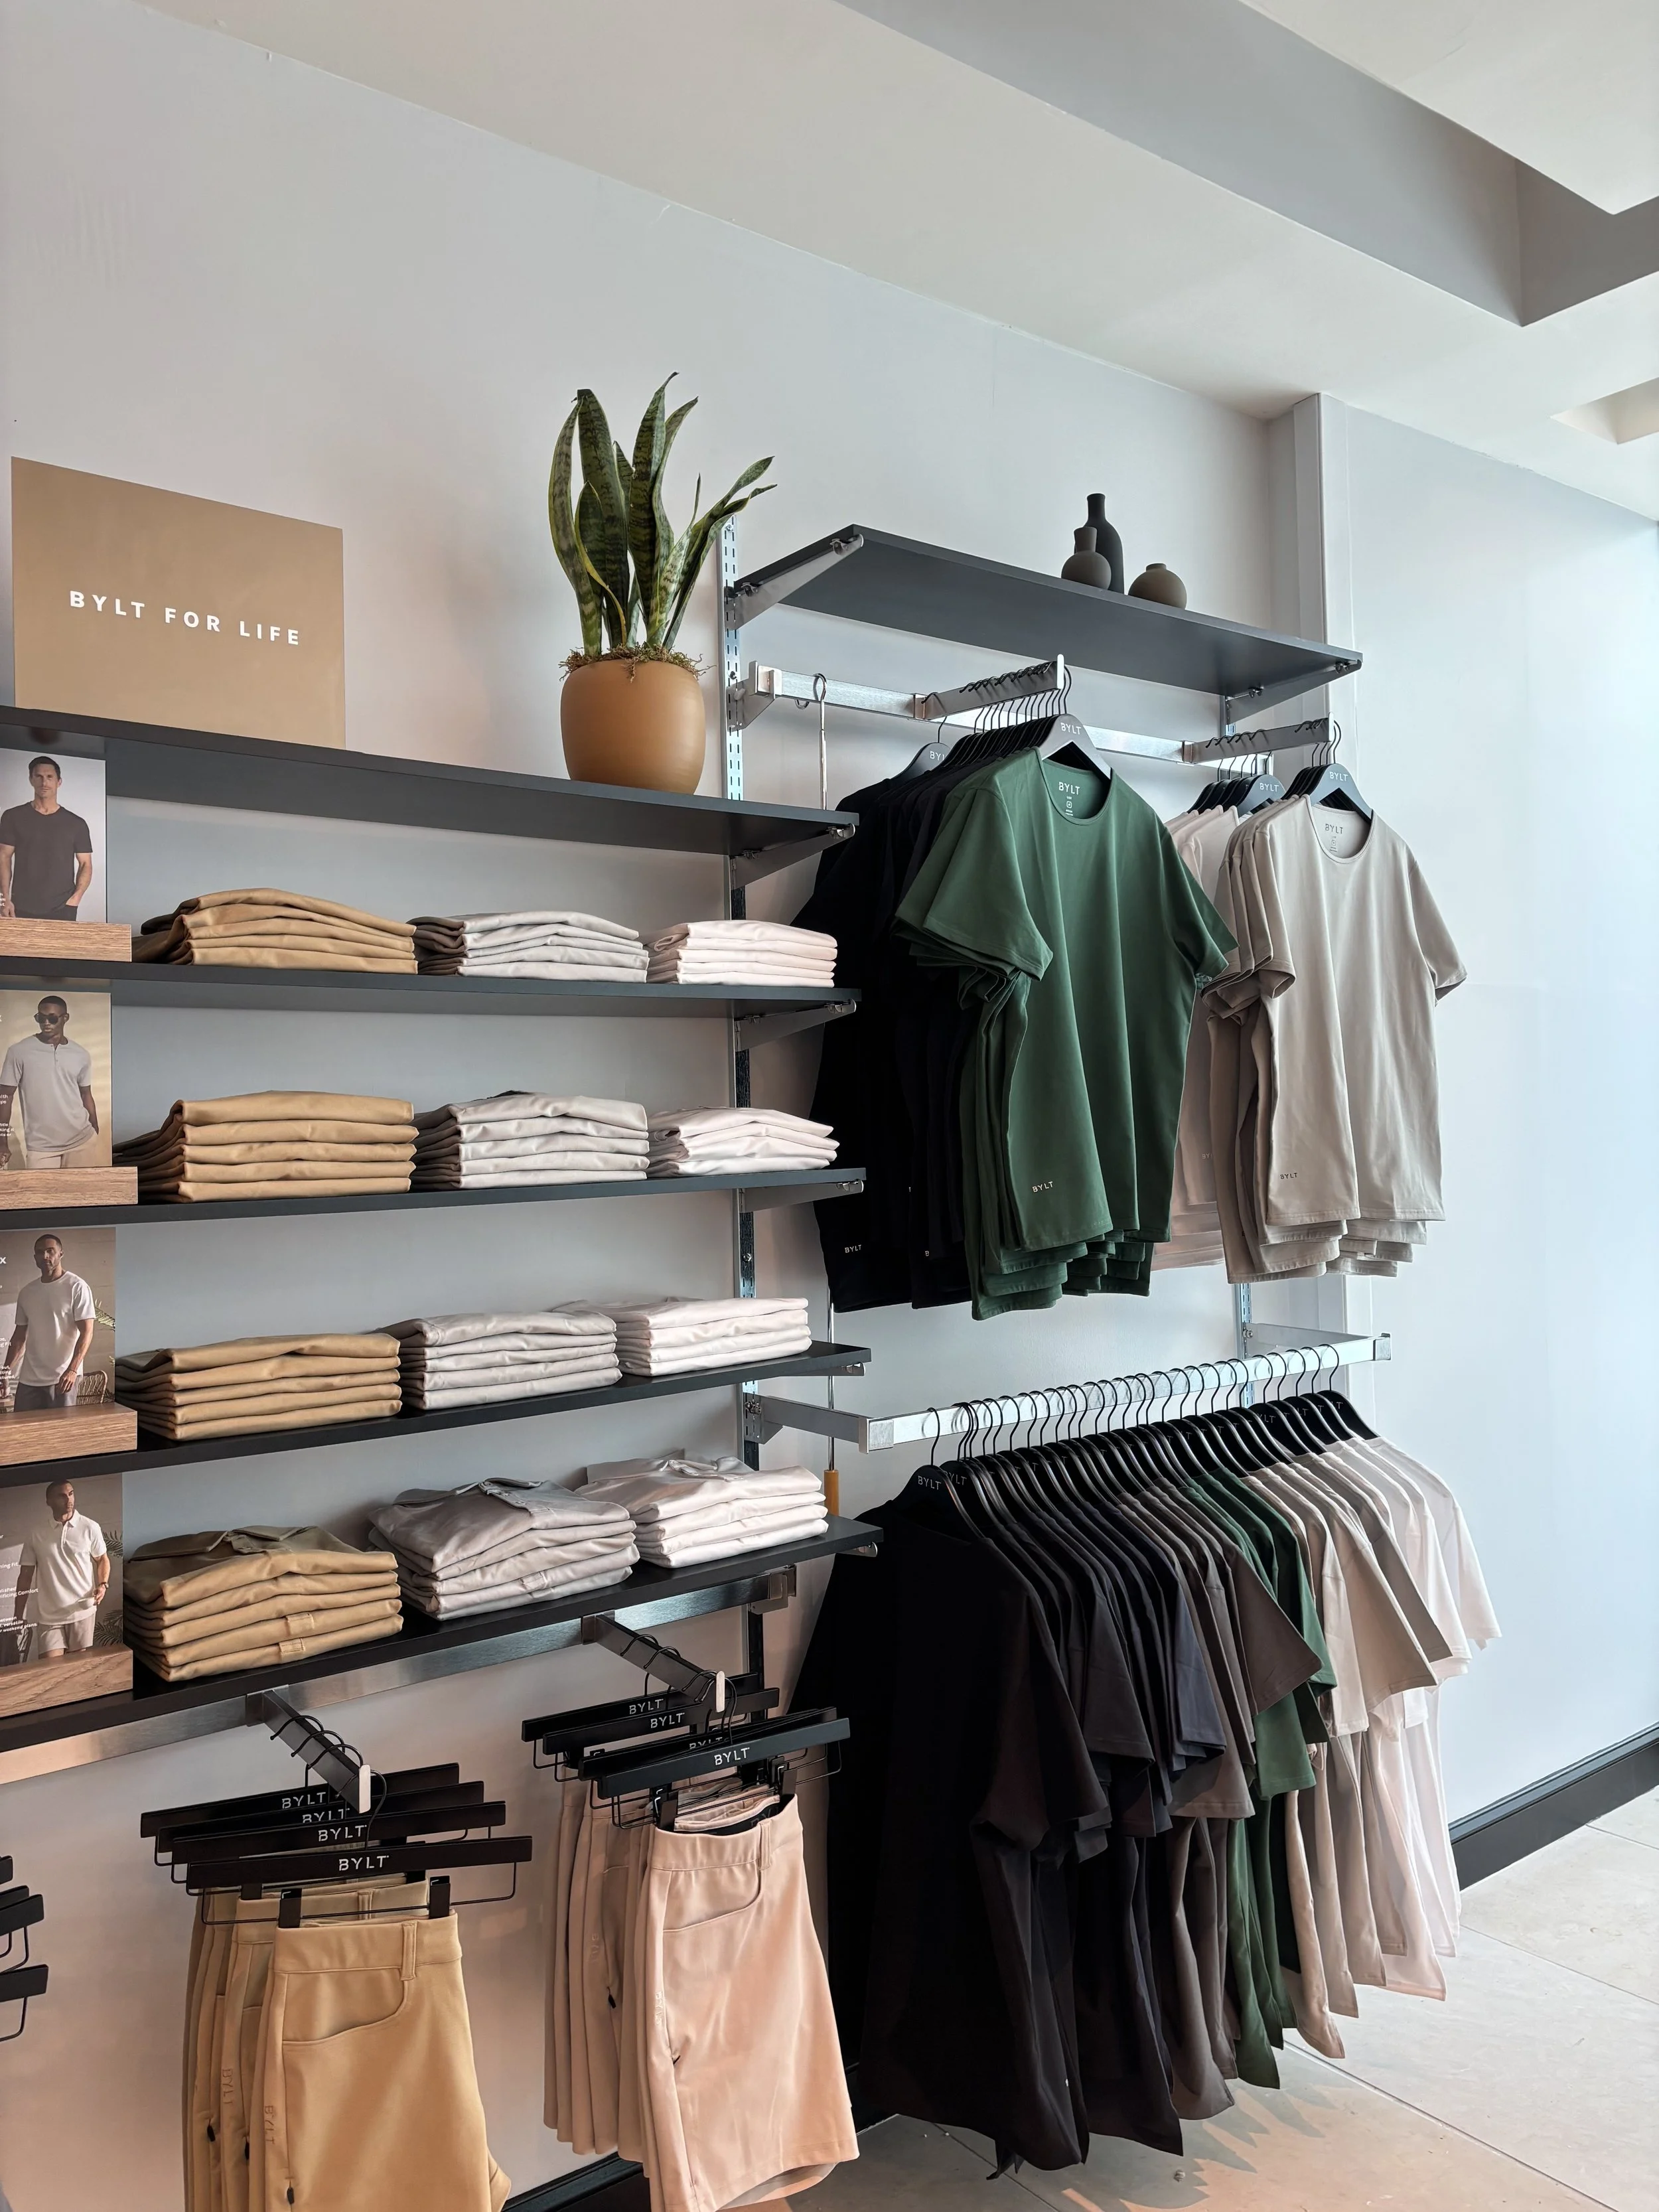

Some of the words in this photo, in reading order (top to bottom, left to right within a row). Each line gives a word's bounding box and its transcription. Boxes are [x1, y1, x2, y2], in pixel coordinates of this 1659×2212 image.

[70, 590, 145, 619] BYLT
[165, 607, 220, 632] FOR
[239, 621, 299, 646] LIFE
[1060, 722, 1082, 735] BYLT
[1330, 771, 1349, 782] BYLT
[1058, 781, 1080, 795] BYLT
[1260, 782, 1279, 792] BYLT
[1325, 823, 1344, 834] BYLT
[1032, 1181, 1053, 1193] BYLT
[844, 1244, 862, 1253] BYLT
[918, 1475, 942, 1490] BYLT
[629, 1698, 664, 1714] BYLT
[650, 1712, 685, 1728] BYLT
[714, 1747, 750, 1765] BYLT
[281, 1792, 326, 1809] BYLT
[302, 1808, 348, 1823] BYLT
[318, 1824, 366, 1842] BYLT
[338, 1856, 390, 1871] BYLT
